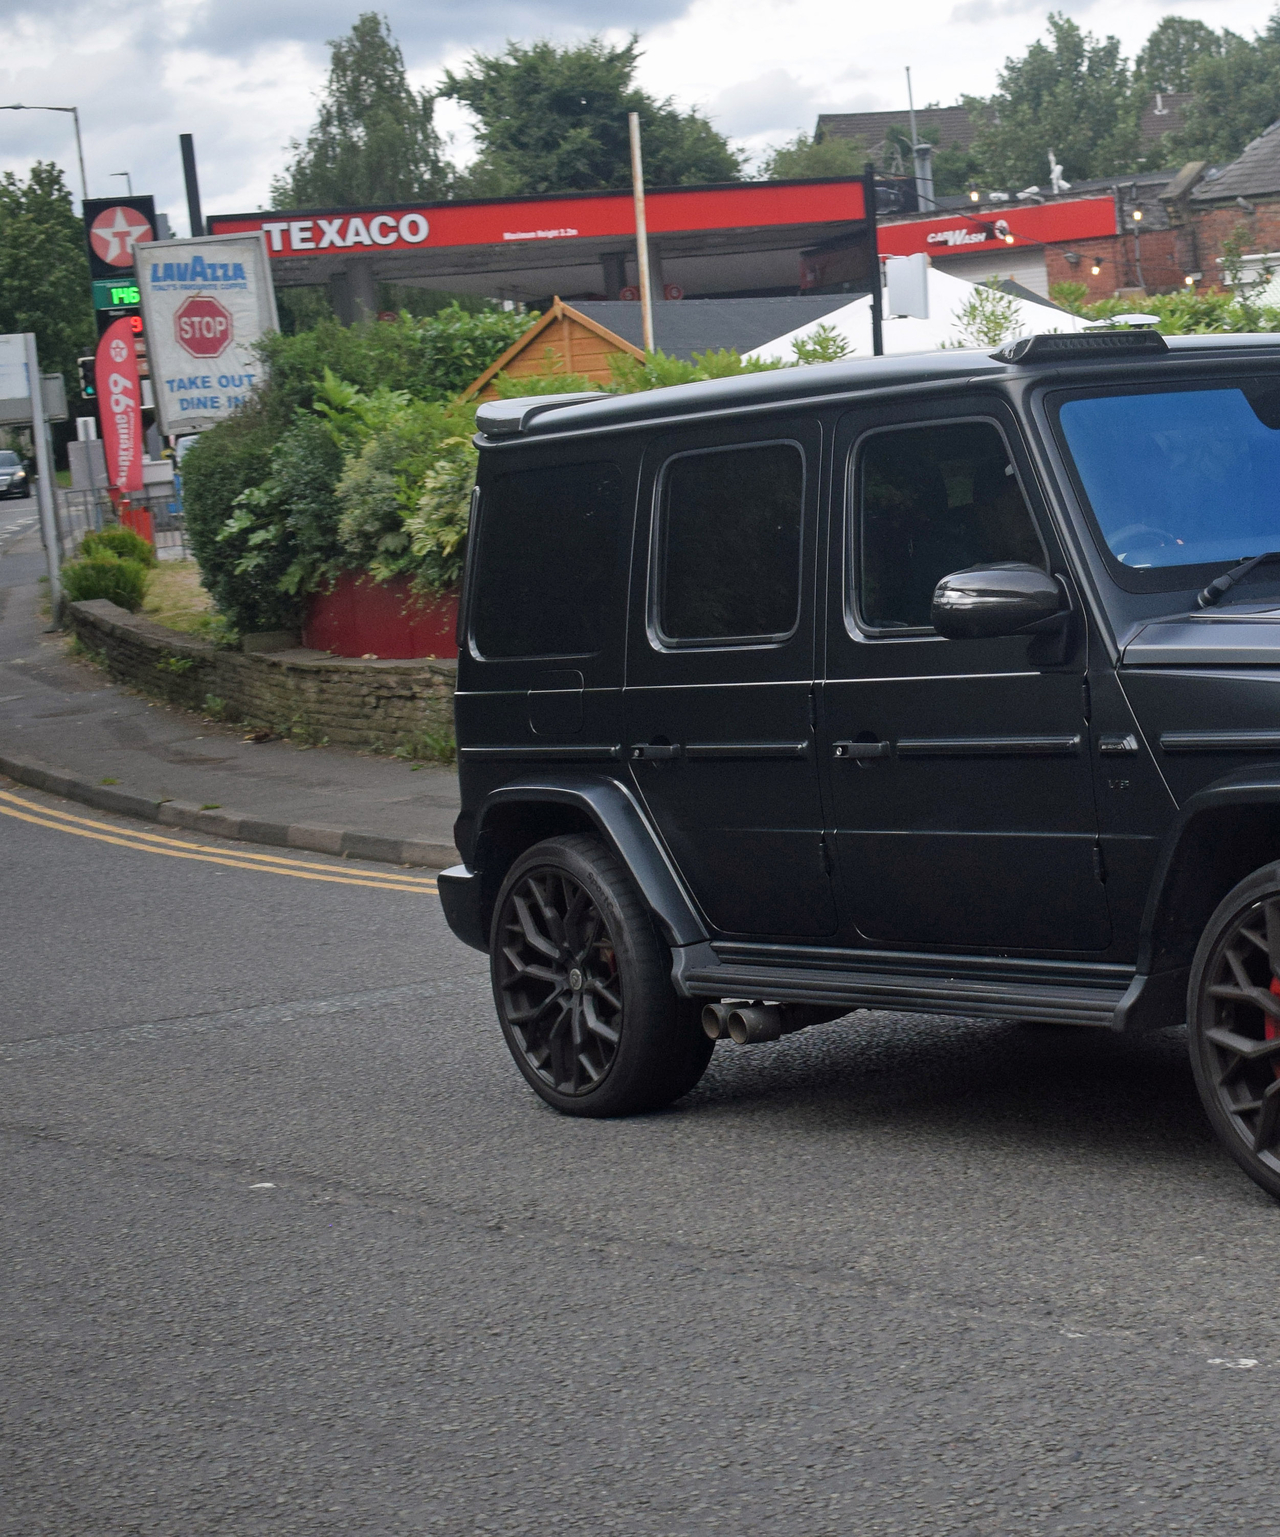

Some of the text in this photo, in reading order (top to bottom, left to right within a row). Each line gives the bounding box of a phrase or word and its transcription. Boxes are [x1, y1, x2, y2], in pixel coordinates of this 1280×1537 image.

[261, 213, 429, 251] TEXACO
[179, 316, 227, 339] STOP
[166, 374, 256, 393] TAKE OUT
[179, 395, 246, 411] DINE IN
